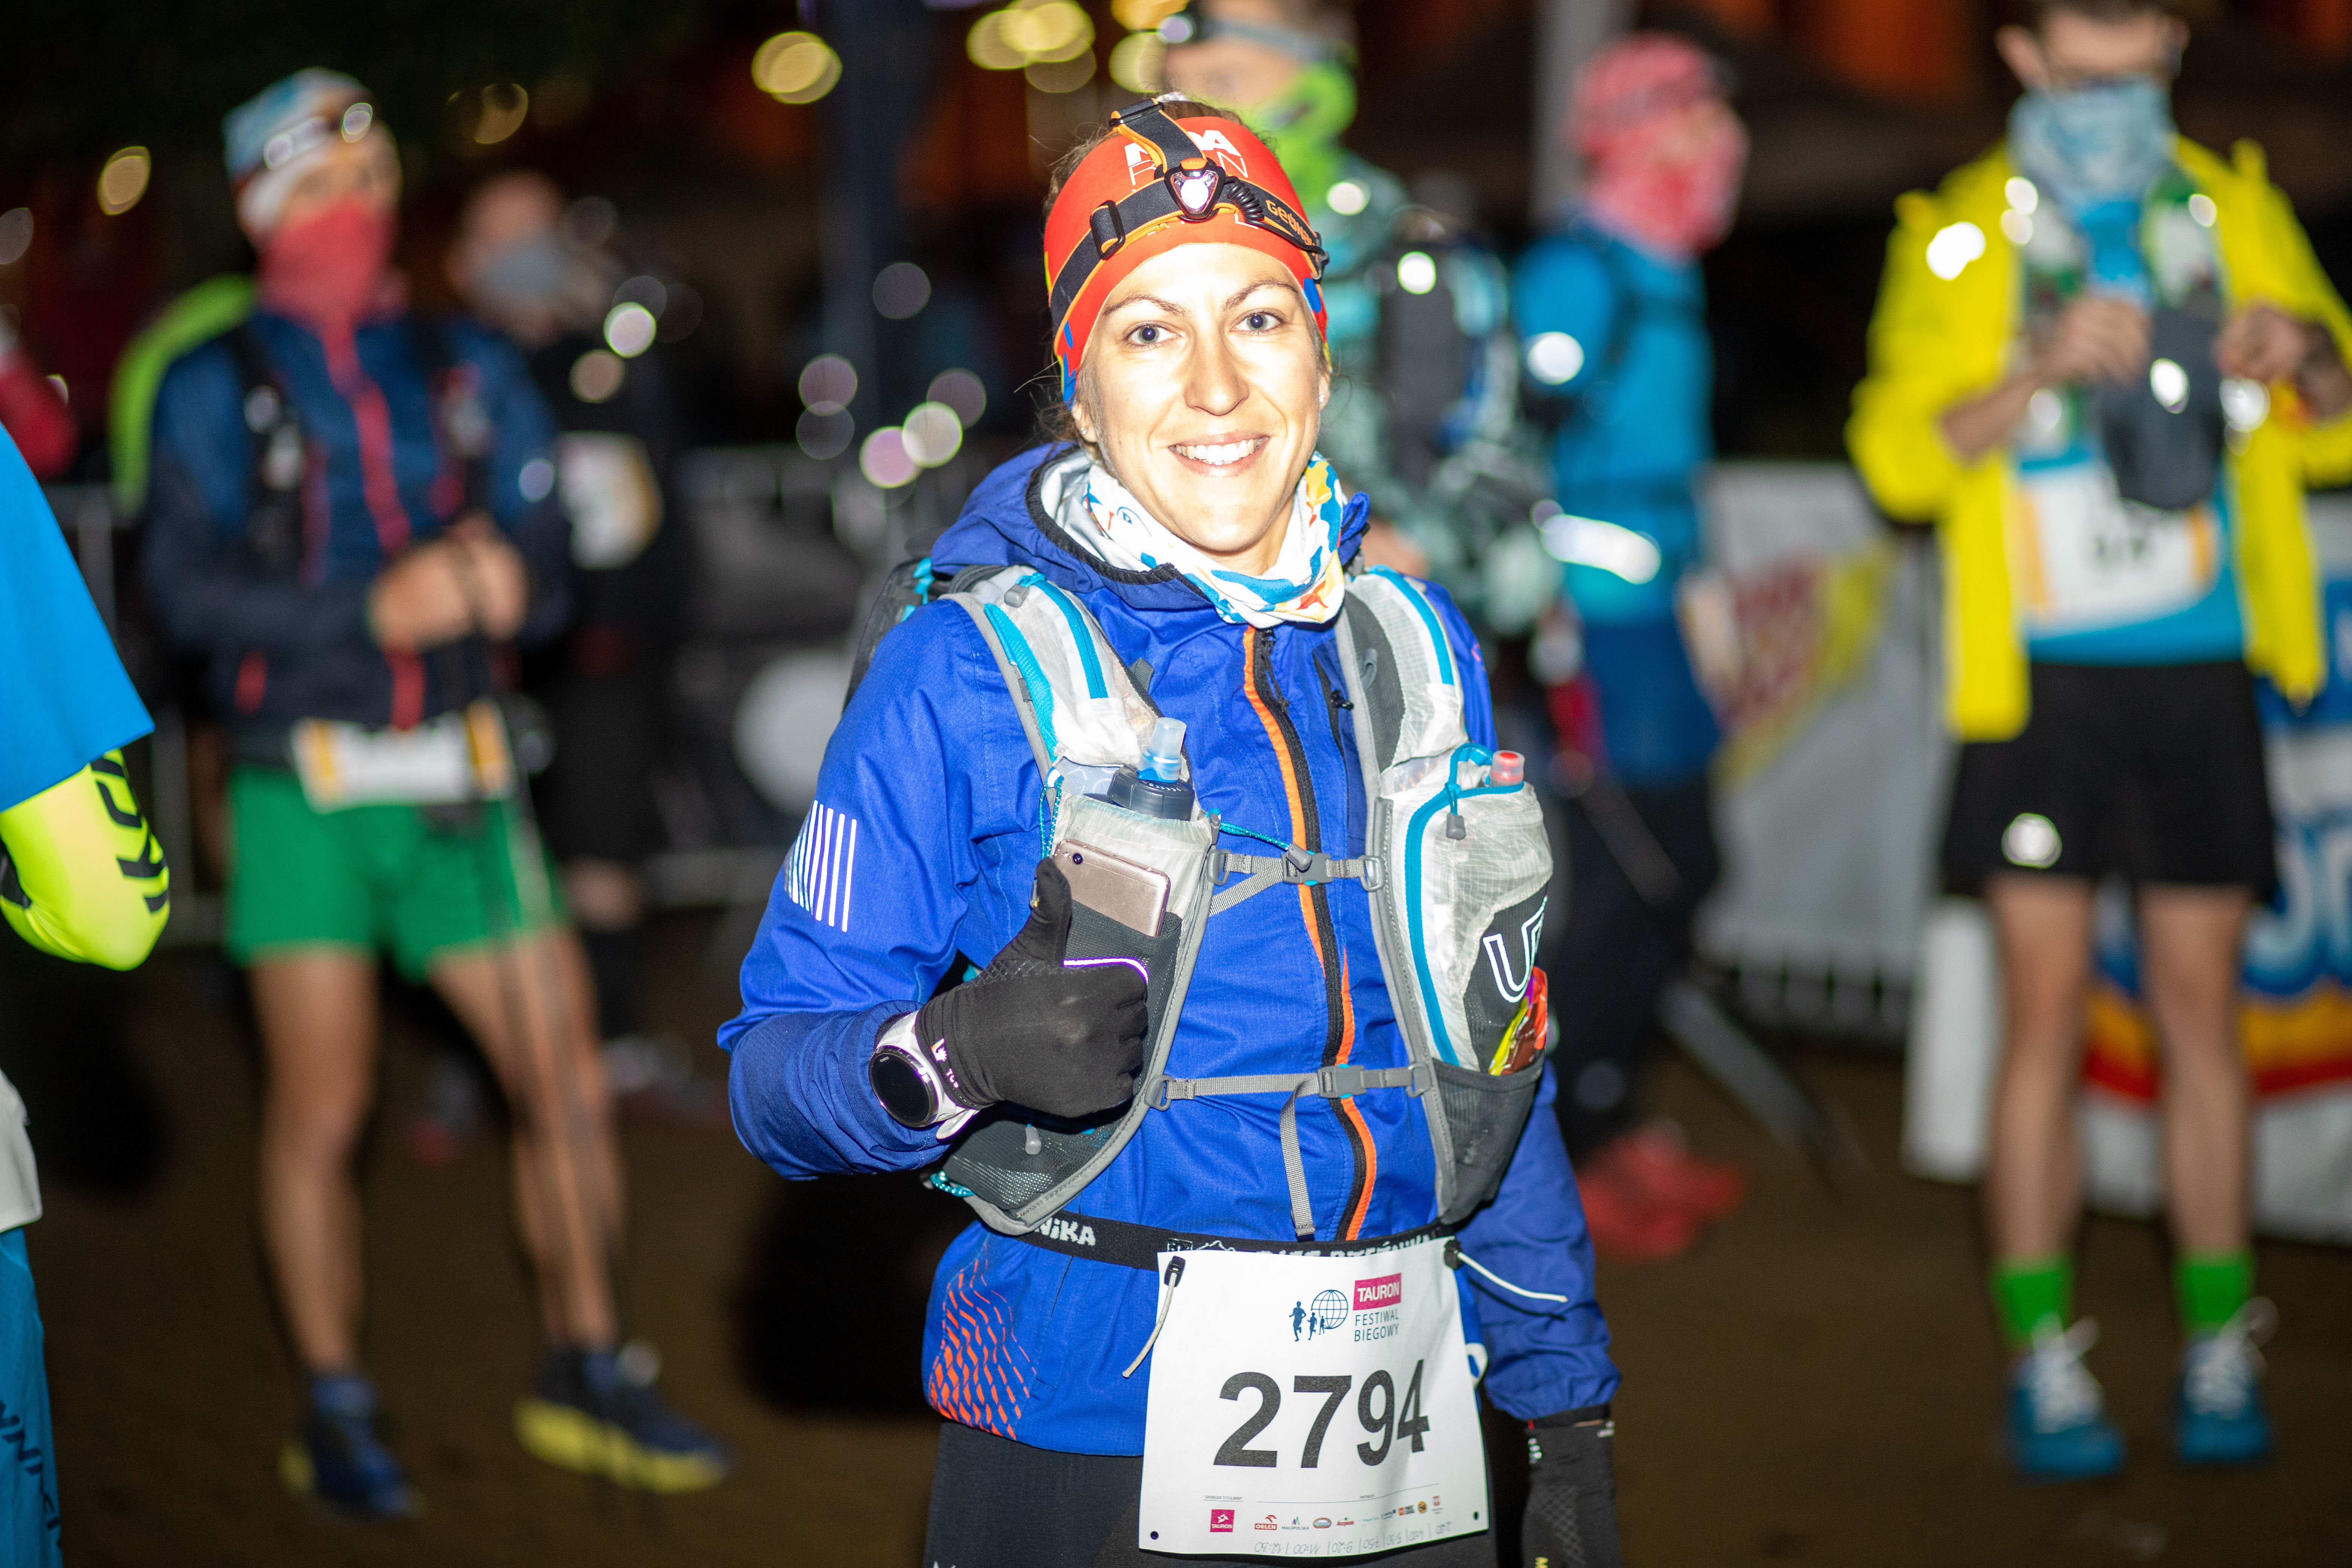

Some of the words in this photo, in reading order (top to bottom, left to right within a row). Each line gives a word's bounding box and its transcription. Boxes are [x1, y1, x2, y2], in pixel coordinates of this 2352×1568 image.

[1357, 1281, 1400, 1302] TAURON
[1355, 1308, 1399, 1326] FESTIWAL
[1354, 1323, 1399, 1342] BIEGOWY
[1213, 1358, 1430, 1468] 2794
[1254, 1541, 1283, 1554] 12:30
